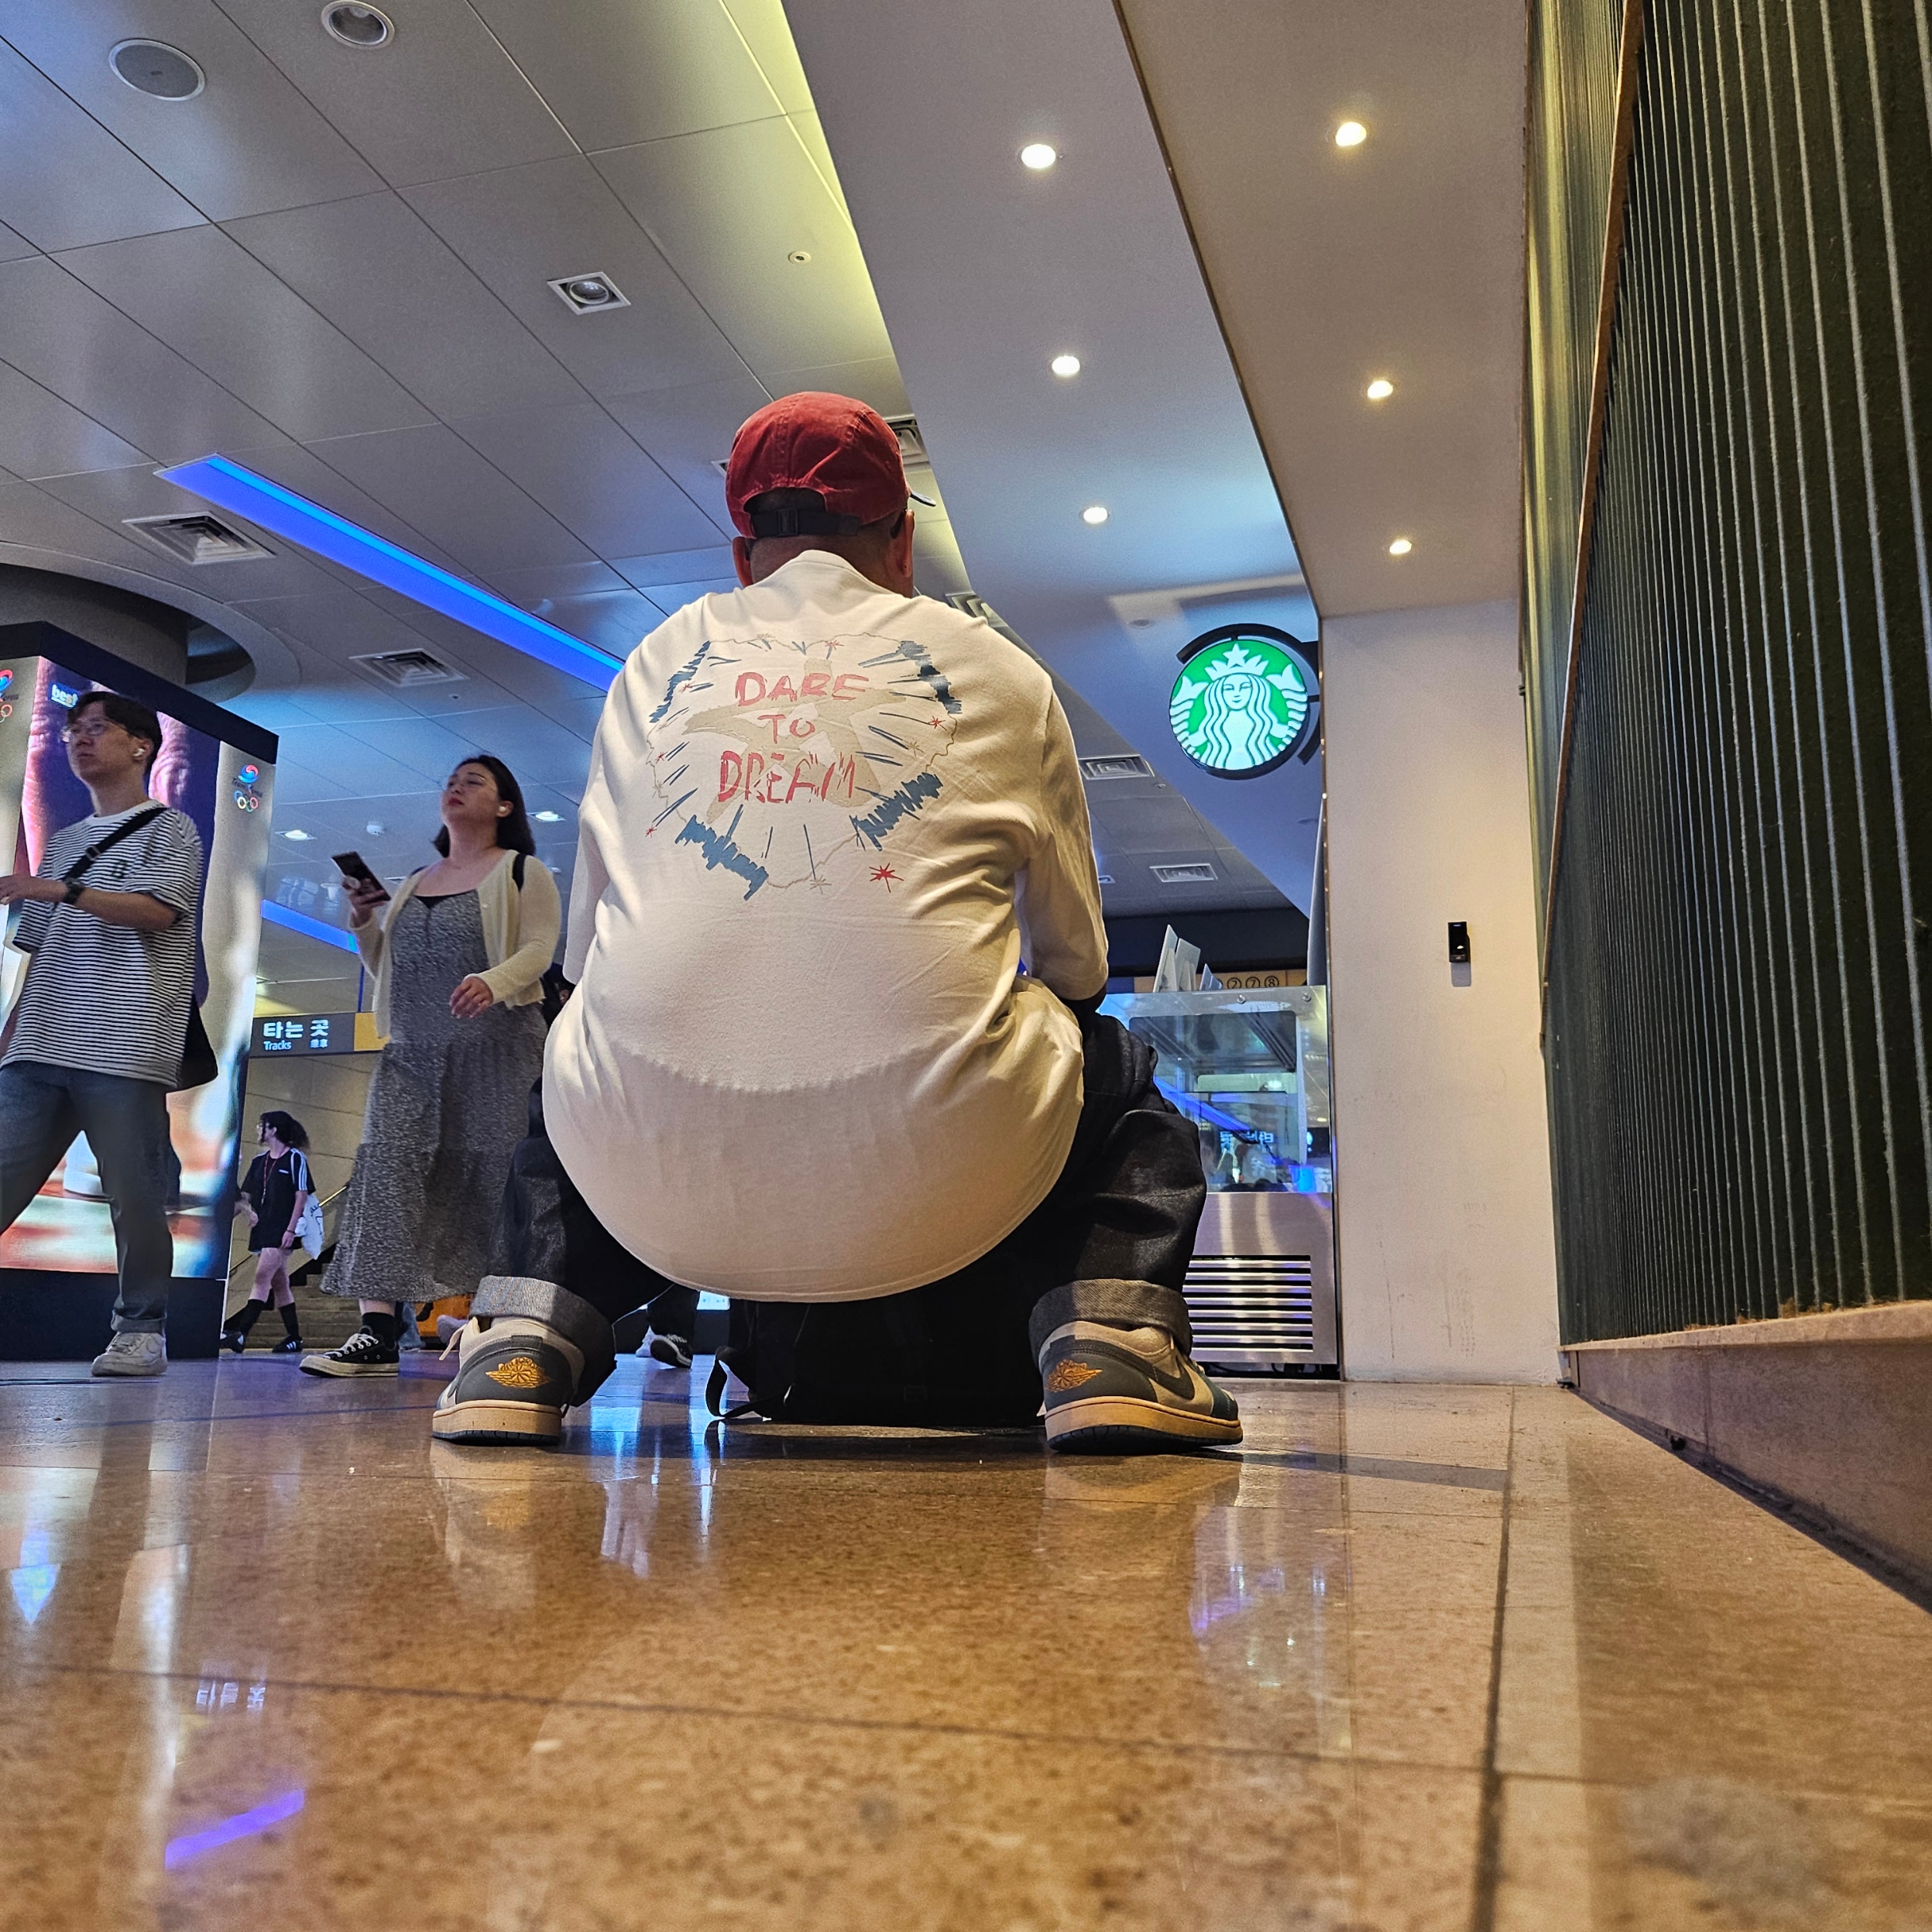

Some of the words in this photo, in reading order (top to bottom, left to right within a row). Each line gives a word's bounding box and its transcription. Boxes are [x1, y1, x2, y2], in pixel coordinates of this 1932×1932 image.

[51, 684, 78, 705] best
[735, 671, 869, 707] DARE
[757, 714, 815, 743] TO
[718, 750, 855, 804] DREAM
[263, 1021, 304, 1039] 타는
[310, 1019, 329, 1037] 곳
[263, 1039, 293, 1051] Tracks
